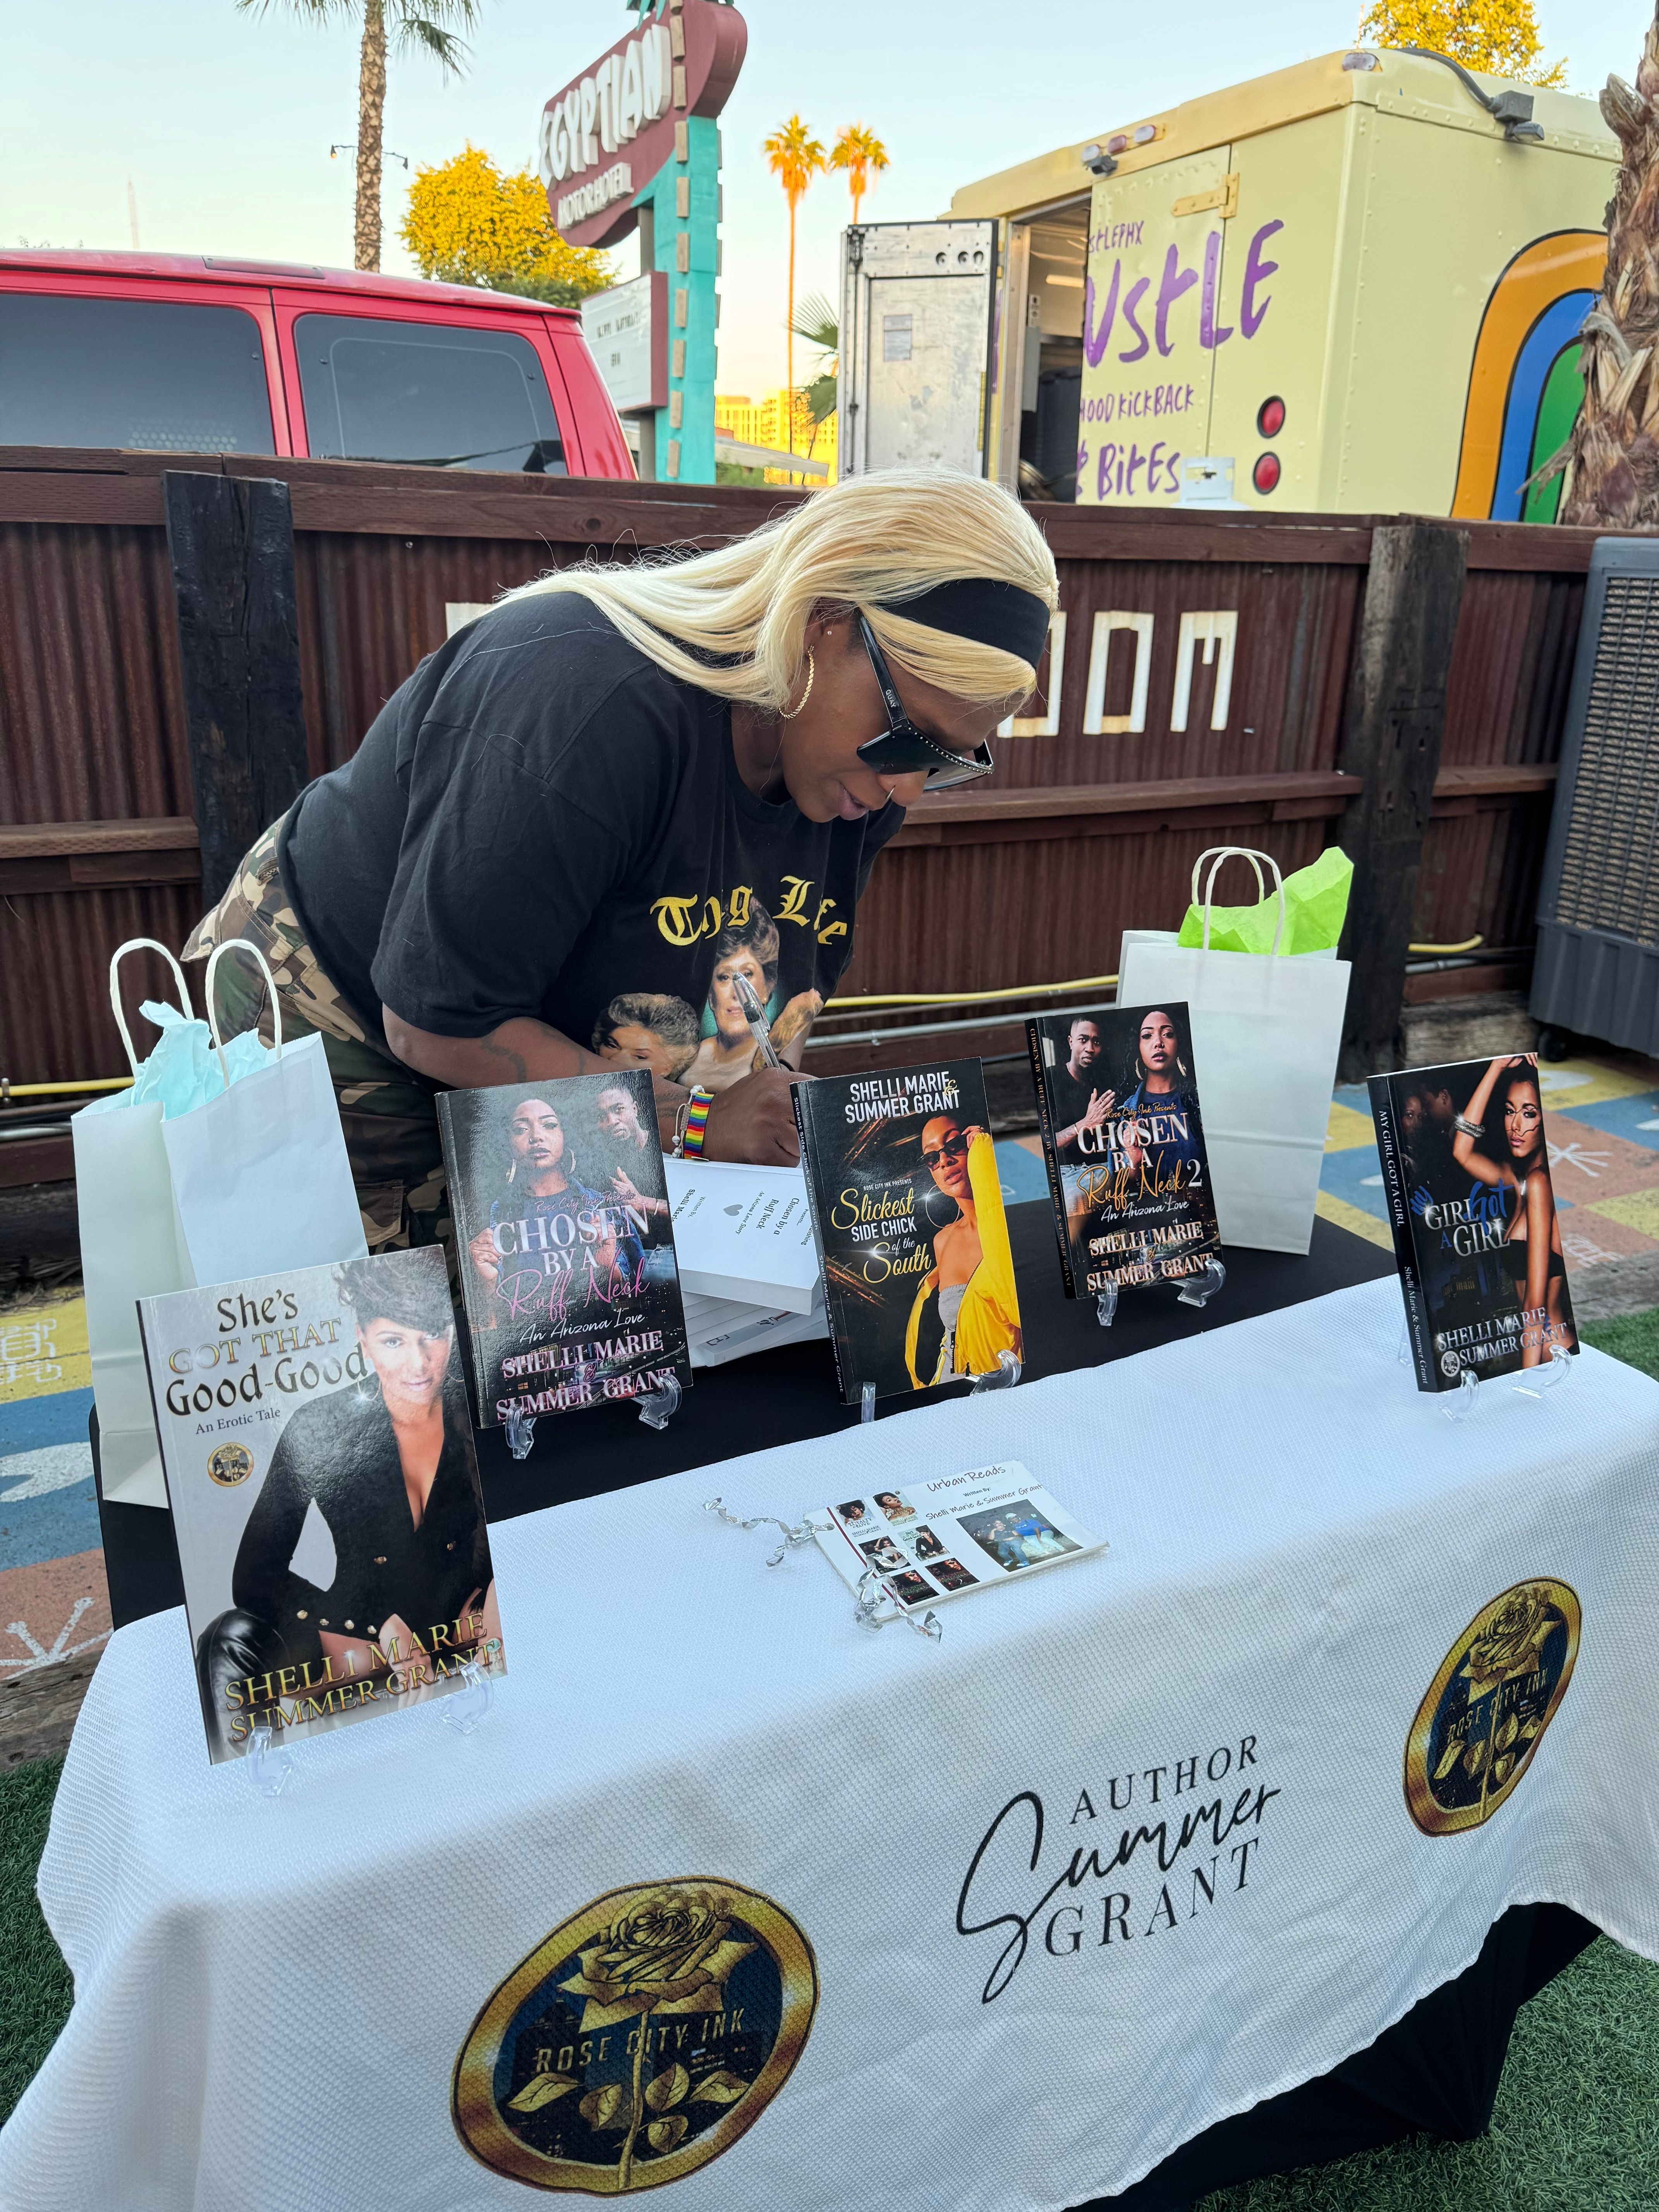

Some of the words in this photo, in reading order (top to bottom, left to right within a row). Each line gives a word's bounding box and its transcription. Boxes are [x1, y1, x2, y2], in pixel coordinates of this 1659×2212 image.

[885, 689, 897, 708] QUAY
[850, 1078, 901, 1103] SHELLI
[904, 1071, 949, 1095] MARIE
[944, 1079, 957, 1096] &
[845, 1097, 910, 1123] SUMMER
[913, 1089, 960, 1114] GRANT
[1105, 1108, 1121, 1119] Rose
[1122, 1107, 1137, 1120] City
[1139, 1103, 1152, 1115] Ink
[1152, 1102, 1177, 1113] Presents
[1379, 1111, 1389, 1128] MY
[794, 1097, 802, 1131] Slickest
[807, 1177, 812, 1186] of
[1030, 1028, 1039, 1060] CHOSEN
[1035, 1063, 1041, 1073] BY
[1041, 1109, 1049, 1130] NECK
[1046, 1141, 1052, 1150] BY
[1052, 1185, 1060, 1211] MARIE
[1058, 1223, 1067, 1256] SUMMER
[1077, 1112, 1188, 1155] CHOSEN
[1383, 1130, 1393, 1158] GIRL
[1112, 1151, 1135, 1173] BY
[1139, 1148, 1153, 1169] A
[1388, 1160, 1398, 1187] GOT
[680, 1189, 695, 1205] Shelli
[892, 1178, 912, 1187] PRESENTS
[1077, 1165, 1130, 1211] Ruff
[1137, 1150, 1186, 1202] Neck
[1187, 1159, 1202, 1187] 2
[534, 1200, 556, 1212] Rose
[559, 1197, 579, 1214] City
[581, 1193, 600, 1206] Ink
[601, 1190, 635, 1204] Presents
[693, 1197, 706, 1211] Written
[743, 1212, 752, 1223] Love
[749, 1197, 761, 1212] Arizona
[764, 1199, 779, 1213] Ruff
[781, 1198, 800, 1219] Chosen
[831, 1187, 915, 1229] Slickest
[1101, 1205, 1119, 1222] An
[1122, 1201, 1166, 1219] Arizona
[1166, 1195, 1189, 1212] Love
[1394, 1199, 1405, 1227] GIRL
[1425, 1199, 1479, 1230] GIRL
[1463, 1177, 1514, 1236] Got
[493, 1202, 650, 1256] CHOSEN
[736, 1223, 746, 1235] Story
[756, 1212, 771, 1229] Neck
[776, 1221, 788, 1229] by
[851, 1223, 879, 1242] SIDE
[881, 1216, 917, 1237] CHICK
[891, 1237, 901, 1256] of
[903, 1237, 915, 1249] the
[1089, 1230, 1147, 1256] SHELLI
[1152, 1221, 1204, 1245] MARIE
[1440, 1230, 1452, 1249] A
[1453, 1218, 1510, 1257] GIRL
[542, 1249, 577, 1277] BY
[580, 1246, 599, 1271] A
[863, 1242, 932, 1283] South
[1146, 1247, 1155, 1262] &
[496, 1268, 574, 1322] Ruff
[583, 1246, 651, 1308] Neck
[1086, 1264, 1154, 1291] SUMMER
[1161, 1253, 1213, 1277] GRANT
[1404, 1267, 1415, 1289] Shelli
[217, 1289, 298, 1332] She's
[1408, 1291, 1417, 1314] Marie
[520, 1324, 546, 1344] An
[550, 1318, 613, 1339] Arizona
[613, 1307, 646, 1328] Love
[830, 1322, 838, 1362] Summer
[1414, 1324, 1424, 1360] Summer
[1438, 1321, 1492, 1351] SHELLI
[1494, 1307, 1546, 1335] MARIE
[169, 1338, 241, 1374] GOT
[252, 1317, 341, 1357] THAT
[502, 1345, 585, 1379] SHELLI
[593, 1330, 663, 1360] MARIE
[1459, 1336, 1519, 1366] SUMMER
[1520, 1322, 1567, 1349] GRANT
[166, 1341, 368, 1416] Good-Good
[583, 1363, 597, 1382] &
[1420, 1359, 1428, 1384] Grant
[496, 1383, 593, 1421] SUMMER
[603, 1366, 675, 1398] GRANT
[196, 1423, 213, 1435] An
[217, 1411, 254, 1430] Erotic
[256, 1407, 281, 1421] Tale
[927, 1476, 966, 1492] Urban
[964, 1465, 1006, 1481] Reads
[963, 1489, 982, 1498] Written
[926, 1509, 949, 1520] Shelli
[950, 1502, 974, 1513] Marie
[983, 1491, 1016, 1504] Summer
[1018, 1484, 1043, 1495] Grant
[225, 1654, 359, 1711] SHELLI
[367, 1611, 488, 1671] MARIE
[231, 1680, 380, 1741] SUMMER
[386, 1641, 496, 1695] GRANT
[1447, 1705, 1483, 1744] ROSE
[1490, 1682, 1520, 1716] CITY
[1526, 1668, 1547, 1695] INK
[1070, 1735, 1258, 1825] AUTHOR
[956, 1784, 1281, 2004] Summer
[1044, 1838, 1259, 1956] GRANT
[536, 2037, 612, 2073] ROSE
[626, 2024, 688, 2055] CITY
[701, 2008, 744, 2043] INK
